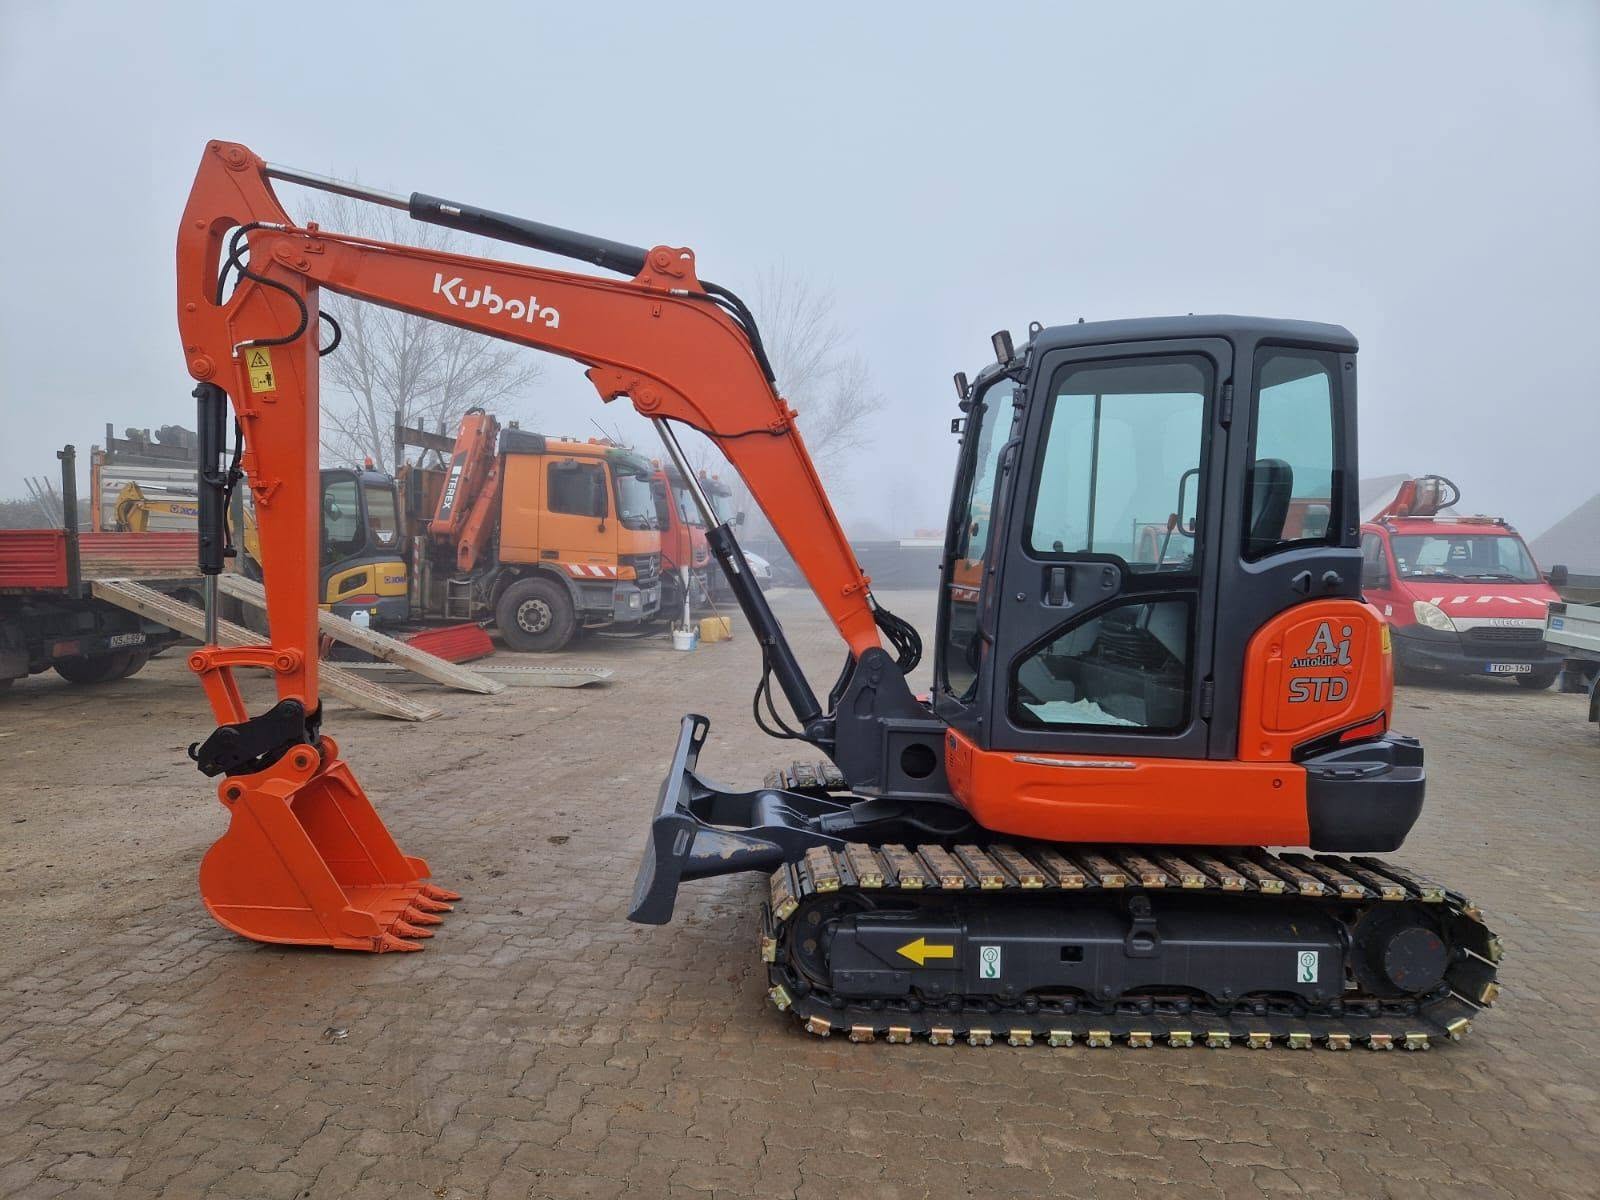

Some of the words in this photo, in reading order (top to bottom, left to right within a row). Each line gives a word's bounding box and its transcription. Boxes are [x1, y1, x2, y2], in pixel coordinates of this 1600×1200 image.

[432, 272, 560, 329] Kubota
[442, 475, 459, 509] TEREX
[1288, 676, 1349, 703] STD
